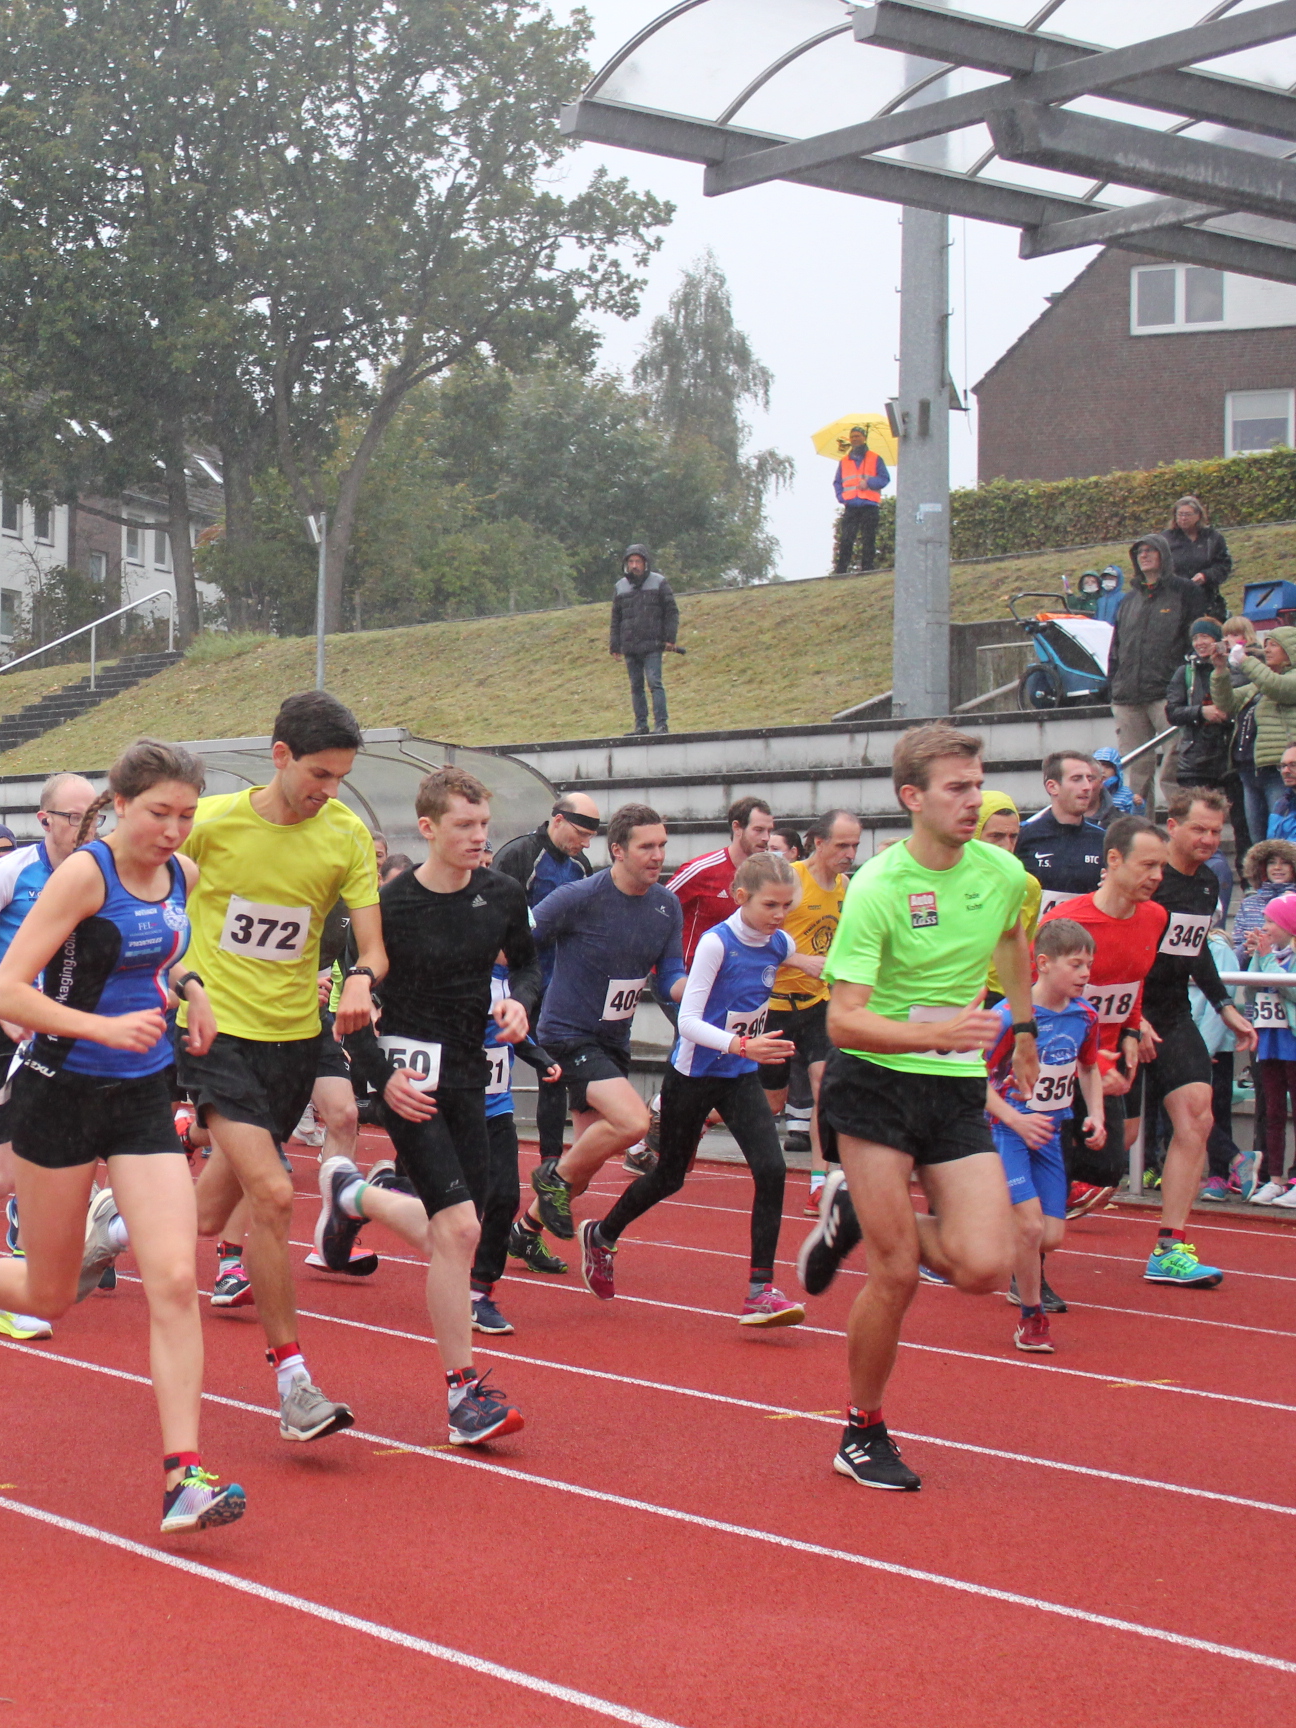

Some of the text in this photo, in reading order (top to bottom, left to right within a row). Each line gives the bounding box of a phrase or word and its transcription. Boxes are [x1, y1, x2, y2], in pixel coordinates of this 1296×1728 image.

[1084, 855, 1100, 864] BTC
[230, 913, 301, 950] 372
[1169, 924, 1205, 948] 346
[1088, 993, 1132, 1016] 318
[387, 1047, 431, 1082] 50
